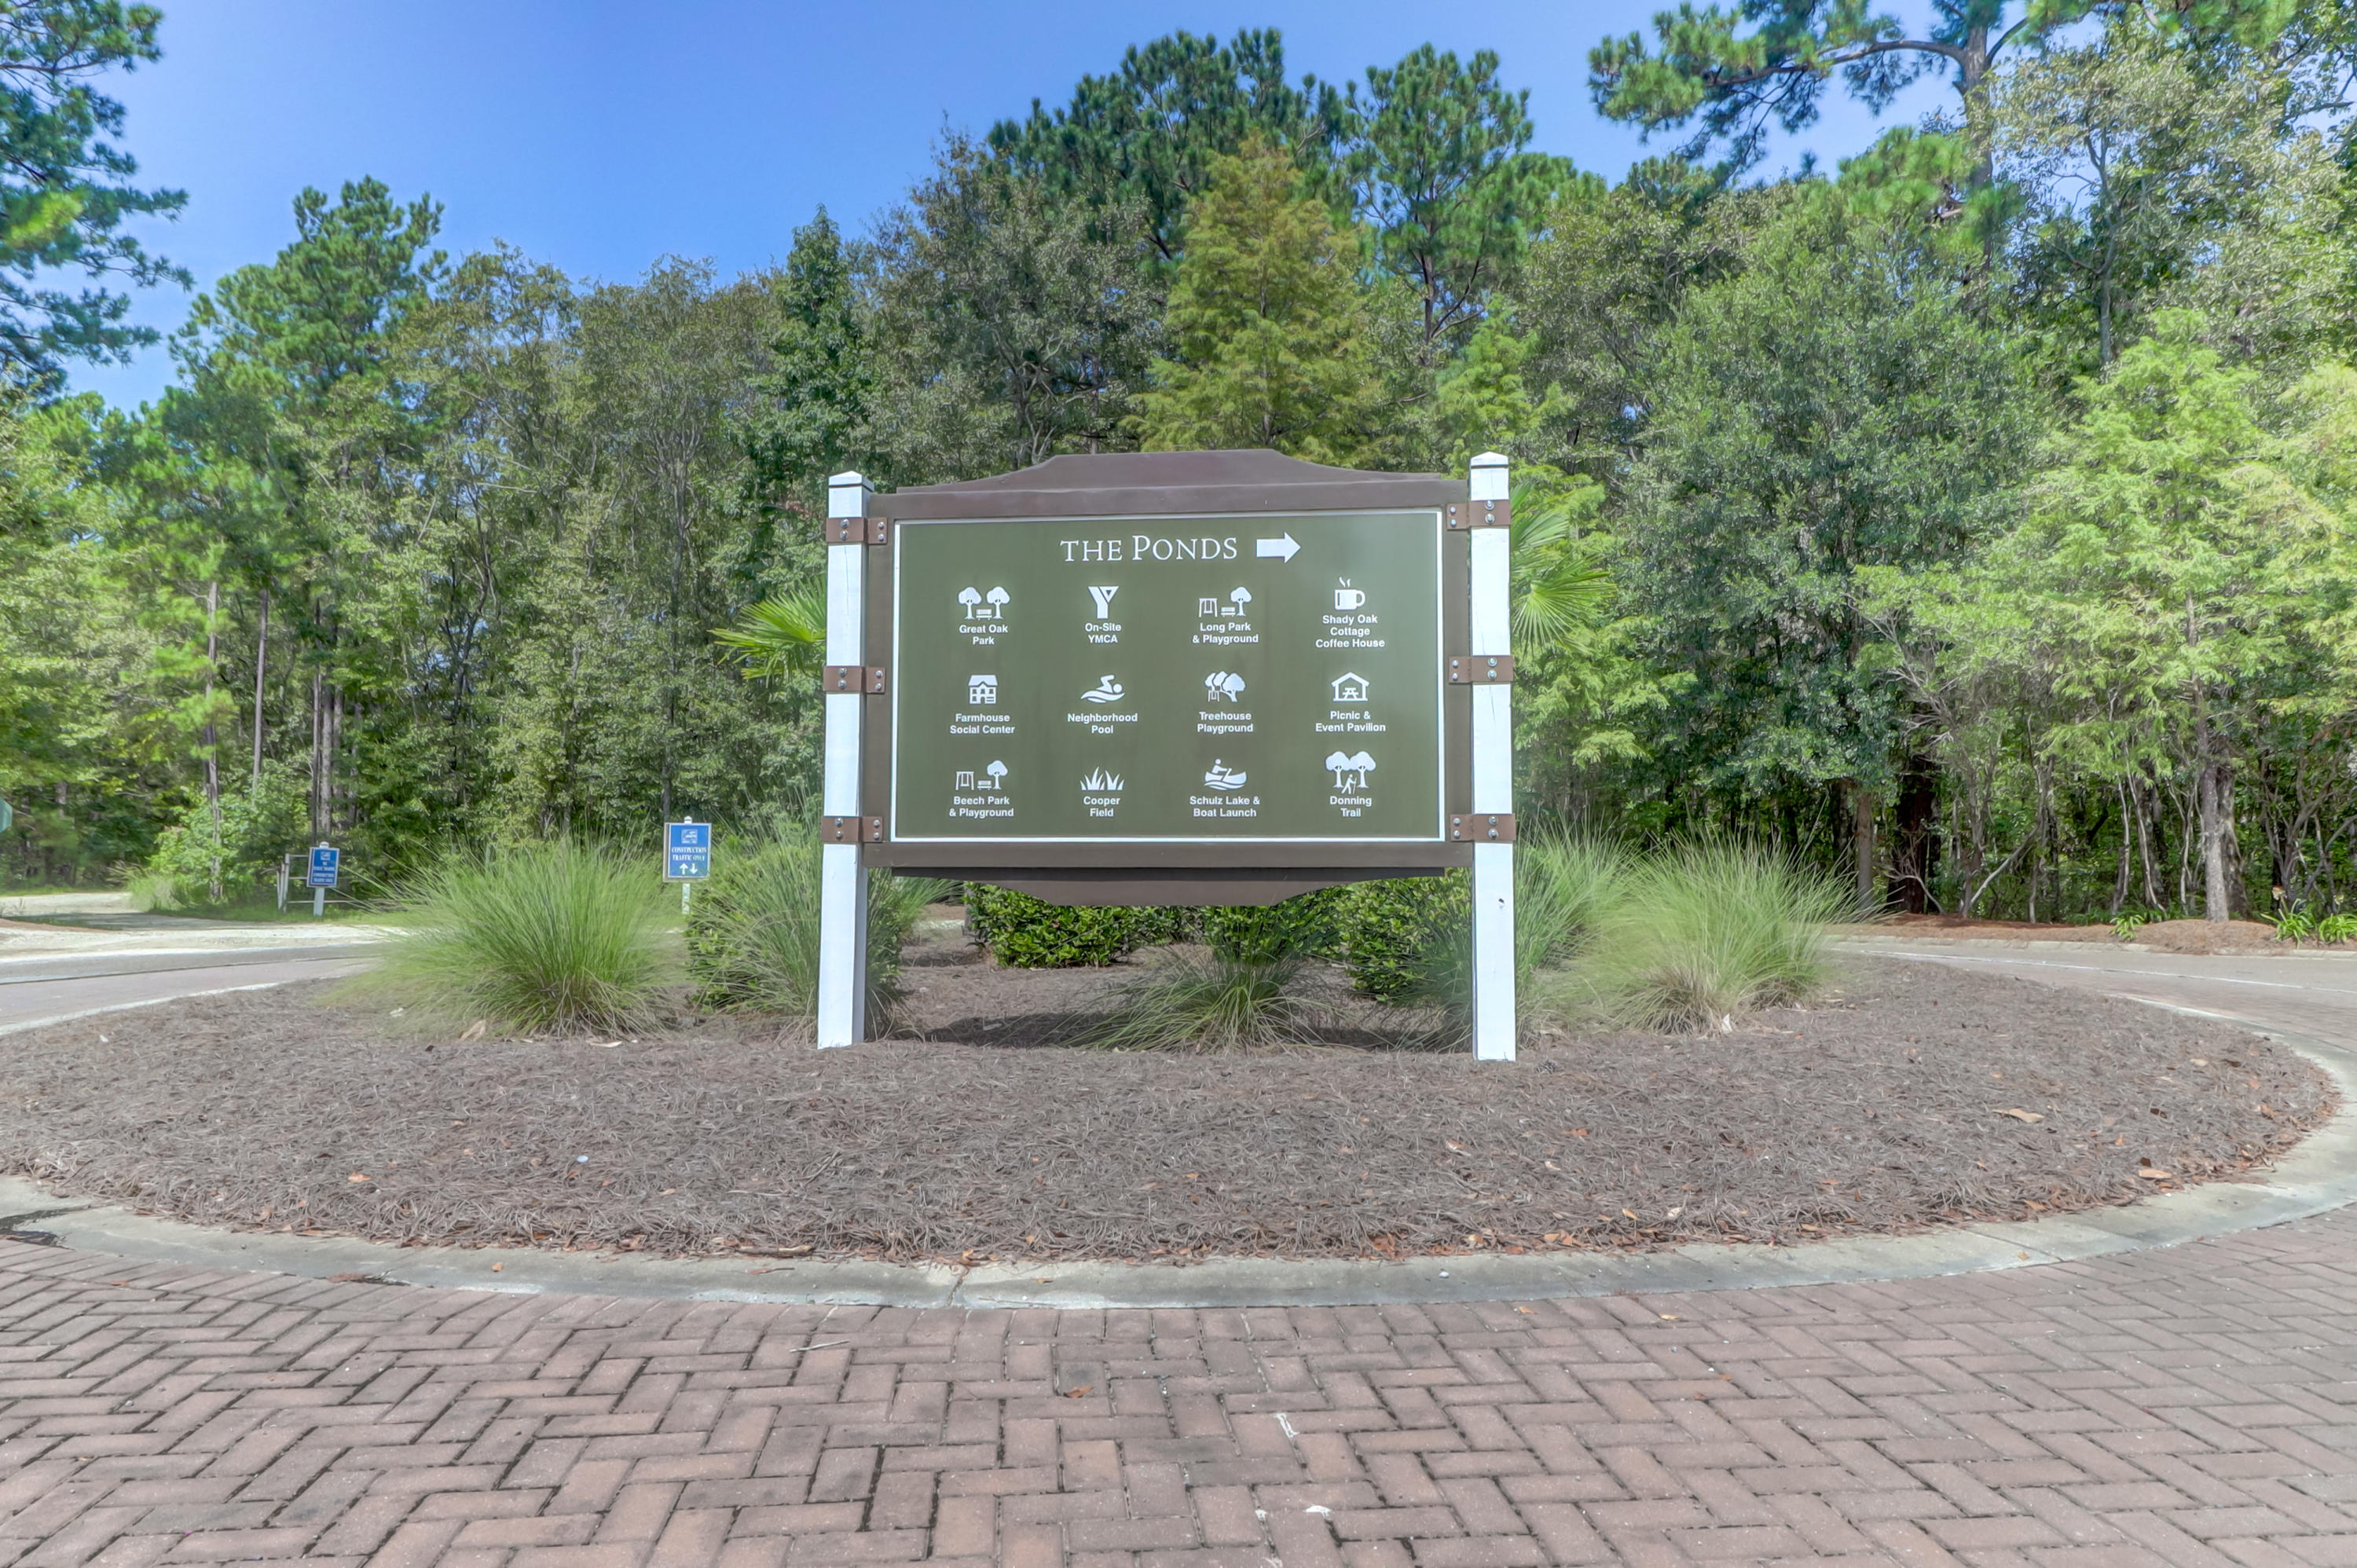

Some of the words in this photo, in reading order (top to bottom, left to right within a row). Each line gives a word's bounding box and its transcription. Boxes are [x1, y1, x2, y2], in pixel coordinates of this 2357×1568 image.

[1059, 540, 1124, 562] THE
[1322, 614, 1354, 626] Shady
[1357, 614, 1378, 624] Oak
[959, 624, 987, 634] Great
[988, 624, 1010, 633] Oak
[1084, 622, 1122, 632] On-Site
[1200, 622, 1226, 634] Long
[1228, 621, 1252, 632] Park
[1329, 626, 1370, 638] Cottage
[972, 636, 995, 645] Park
[1087, 634, 1119, 643] YMCA
[1192, 634, 1200, 644] &
[1202, 633, 1259, 646] Playground
[1315, 638, 1350, 648] Coffee
[1352, 638, 1385, 648] House
[955, 713, 1010, 723] Farmhouse
[1067, 713, 1138, 724] Neighborhood
[1198, 711, 1252, 721] Treehouse
[1330, 710, 1361, 720] Picnic
[1363, 710, 1372, 720] &
[949, 724, 981, 735] Social
[982, 724, 1016, 735] Center
[1091, 724, 1114, 735] Pool
[1197, 723, 1254, 735] Playground
[1315, 722, 1344, 732] Event
[1347, 722, 1387, 732] Pavilion
[953, 796, 985, 805] Beech
[987, 796, 1010, 805] Park
[1083, 795, 1121, 808] Cooper
[1189, 795, 1223, 805] Schulz
[1225, 795, 1251, 805] Lake
[1252, 796, 1260, 805] &
[1329, 795, 1373, 808] Donning
[948, 808, 957, 818] &
[959, 808, 1014, 819] Playground
[1090, 808, 1114, 818] Field
[1193, 808, 1217, 817] Boat
[1219, 808, 1257, 817] Launch
[1340, 808, 1362, 817] Trail
